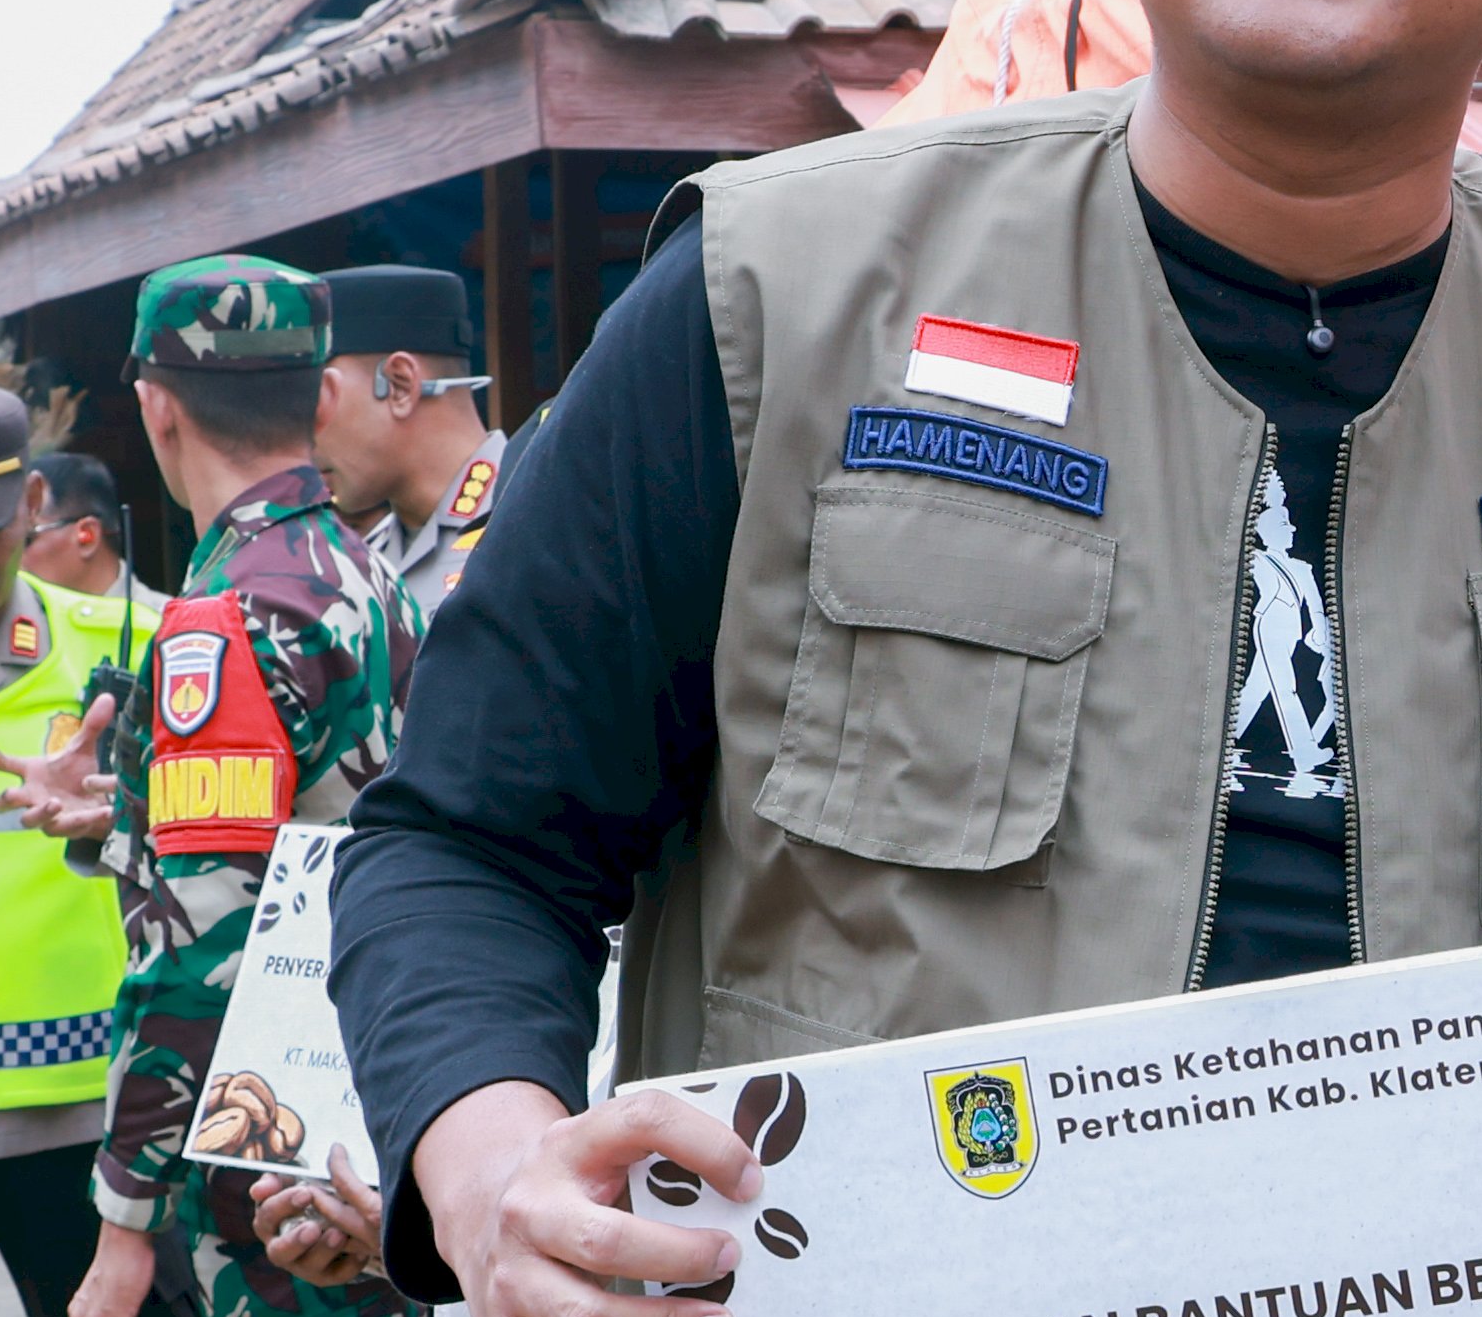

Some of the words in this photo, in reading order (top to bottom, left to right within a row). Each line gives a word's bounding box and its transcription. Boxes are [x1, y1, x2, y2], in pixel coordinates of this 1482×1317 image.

[859, 417, 1091, 497] HAMENANG
[149, 756, 274, 829] ANDIM
[1050, 1062, 1162, 1098] Dinas
[1175, 1027, 1400, 1080] Ketahanan
[1056, 1094, 1256, 1144] Pertanian
[1268, 1077, 1358, 1113] Kab.
